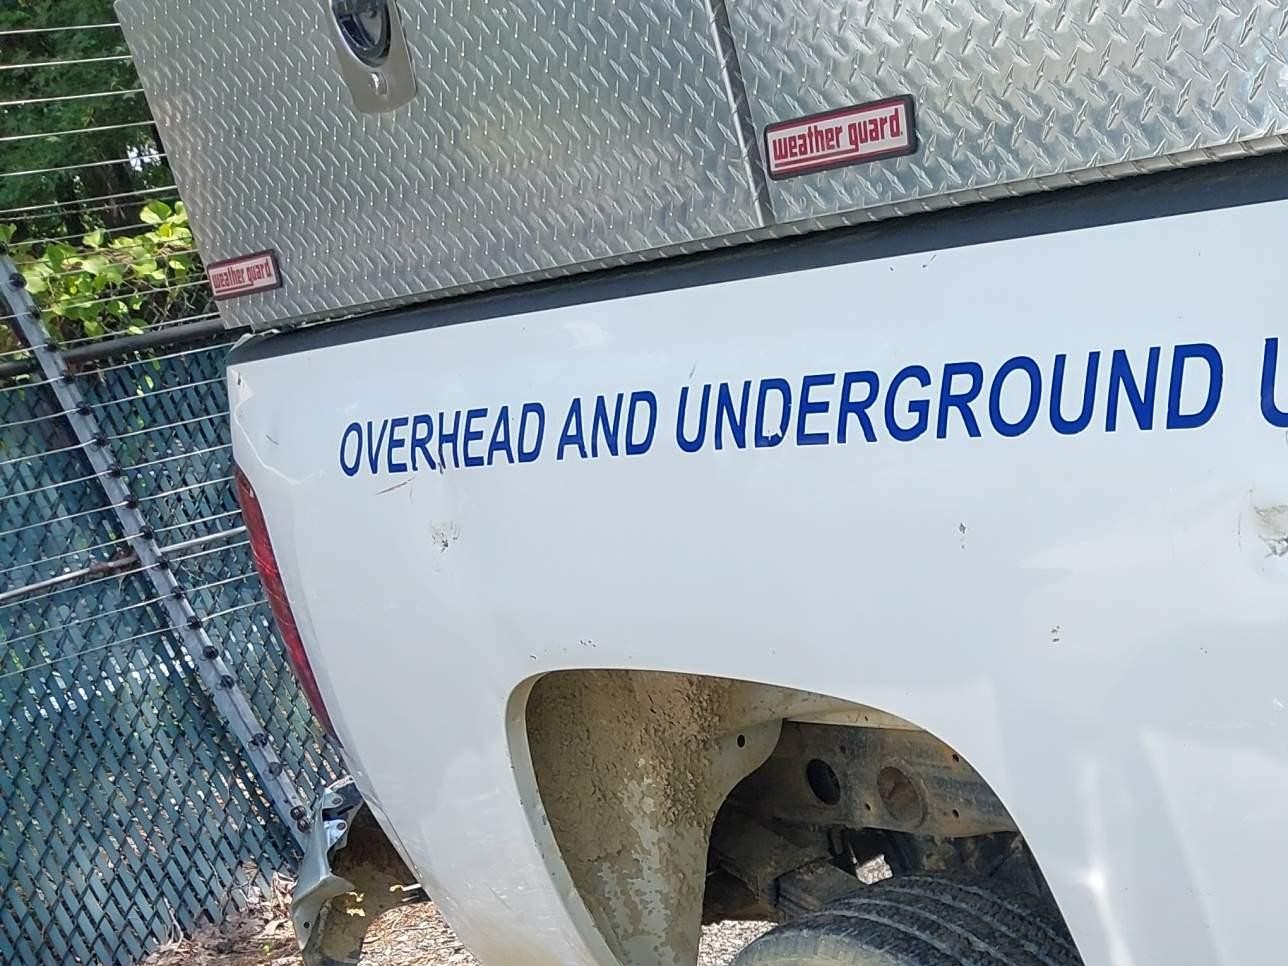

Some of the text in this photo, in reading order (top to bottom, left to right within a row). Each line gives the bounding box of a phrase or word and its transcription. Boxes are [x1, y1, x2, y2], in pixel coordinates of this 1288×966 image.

[772, 107, 903, 161] weather guard
[339, 402, 545, 477] OVERHEAD
[557, 390, 658, 460] AND
[675, 342, 1224, 453] UNDERGROUND
